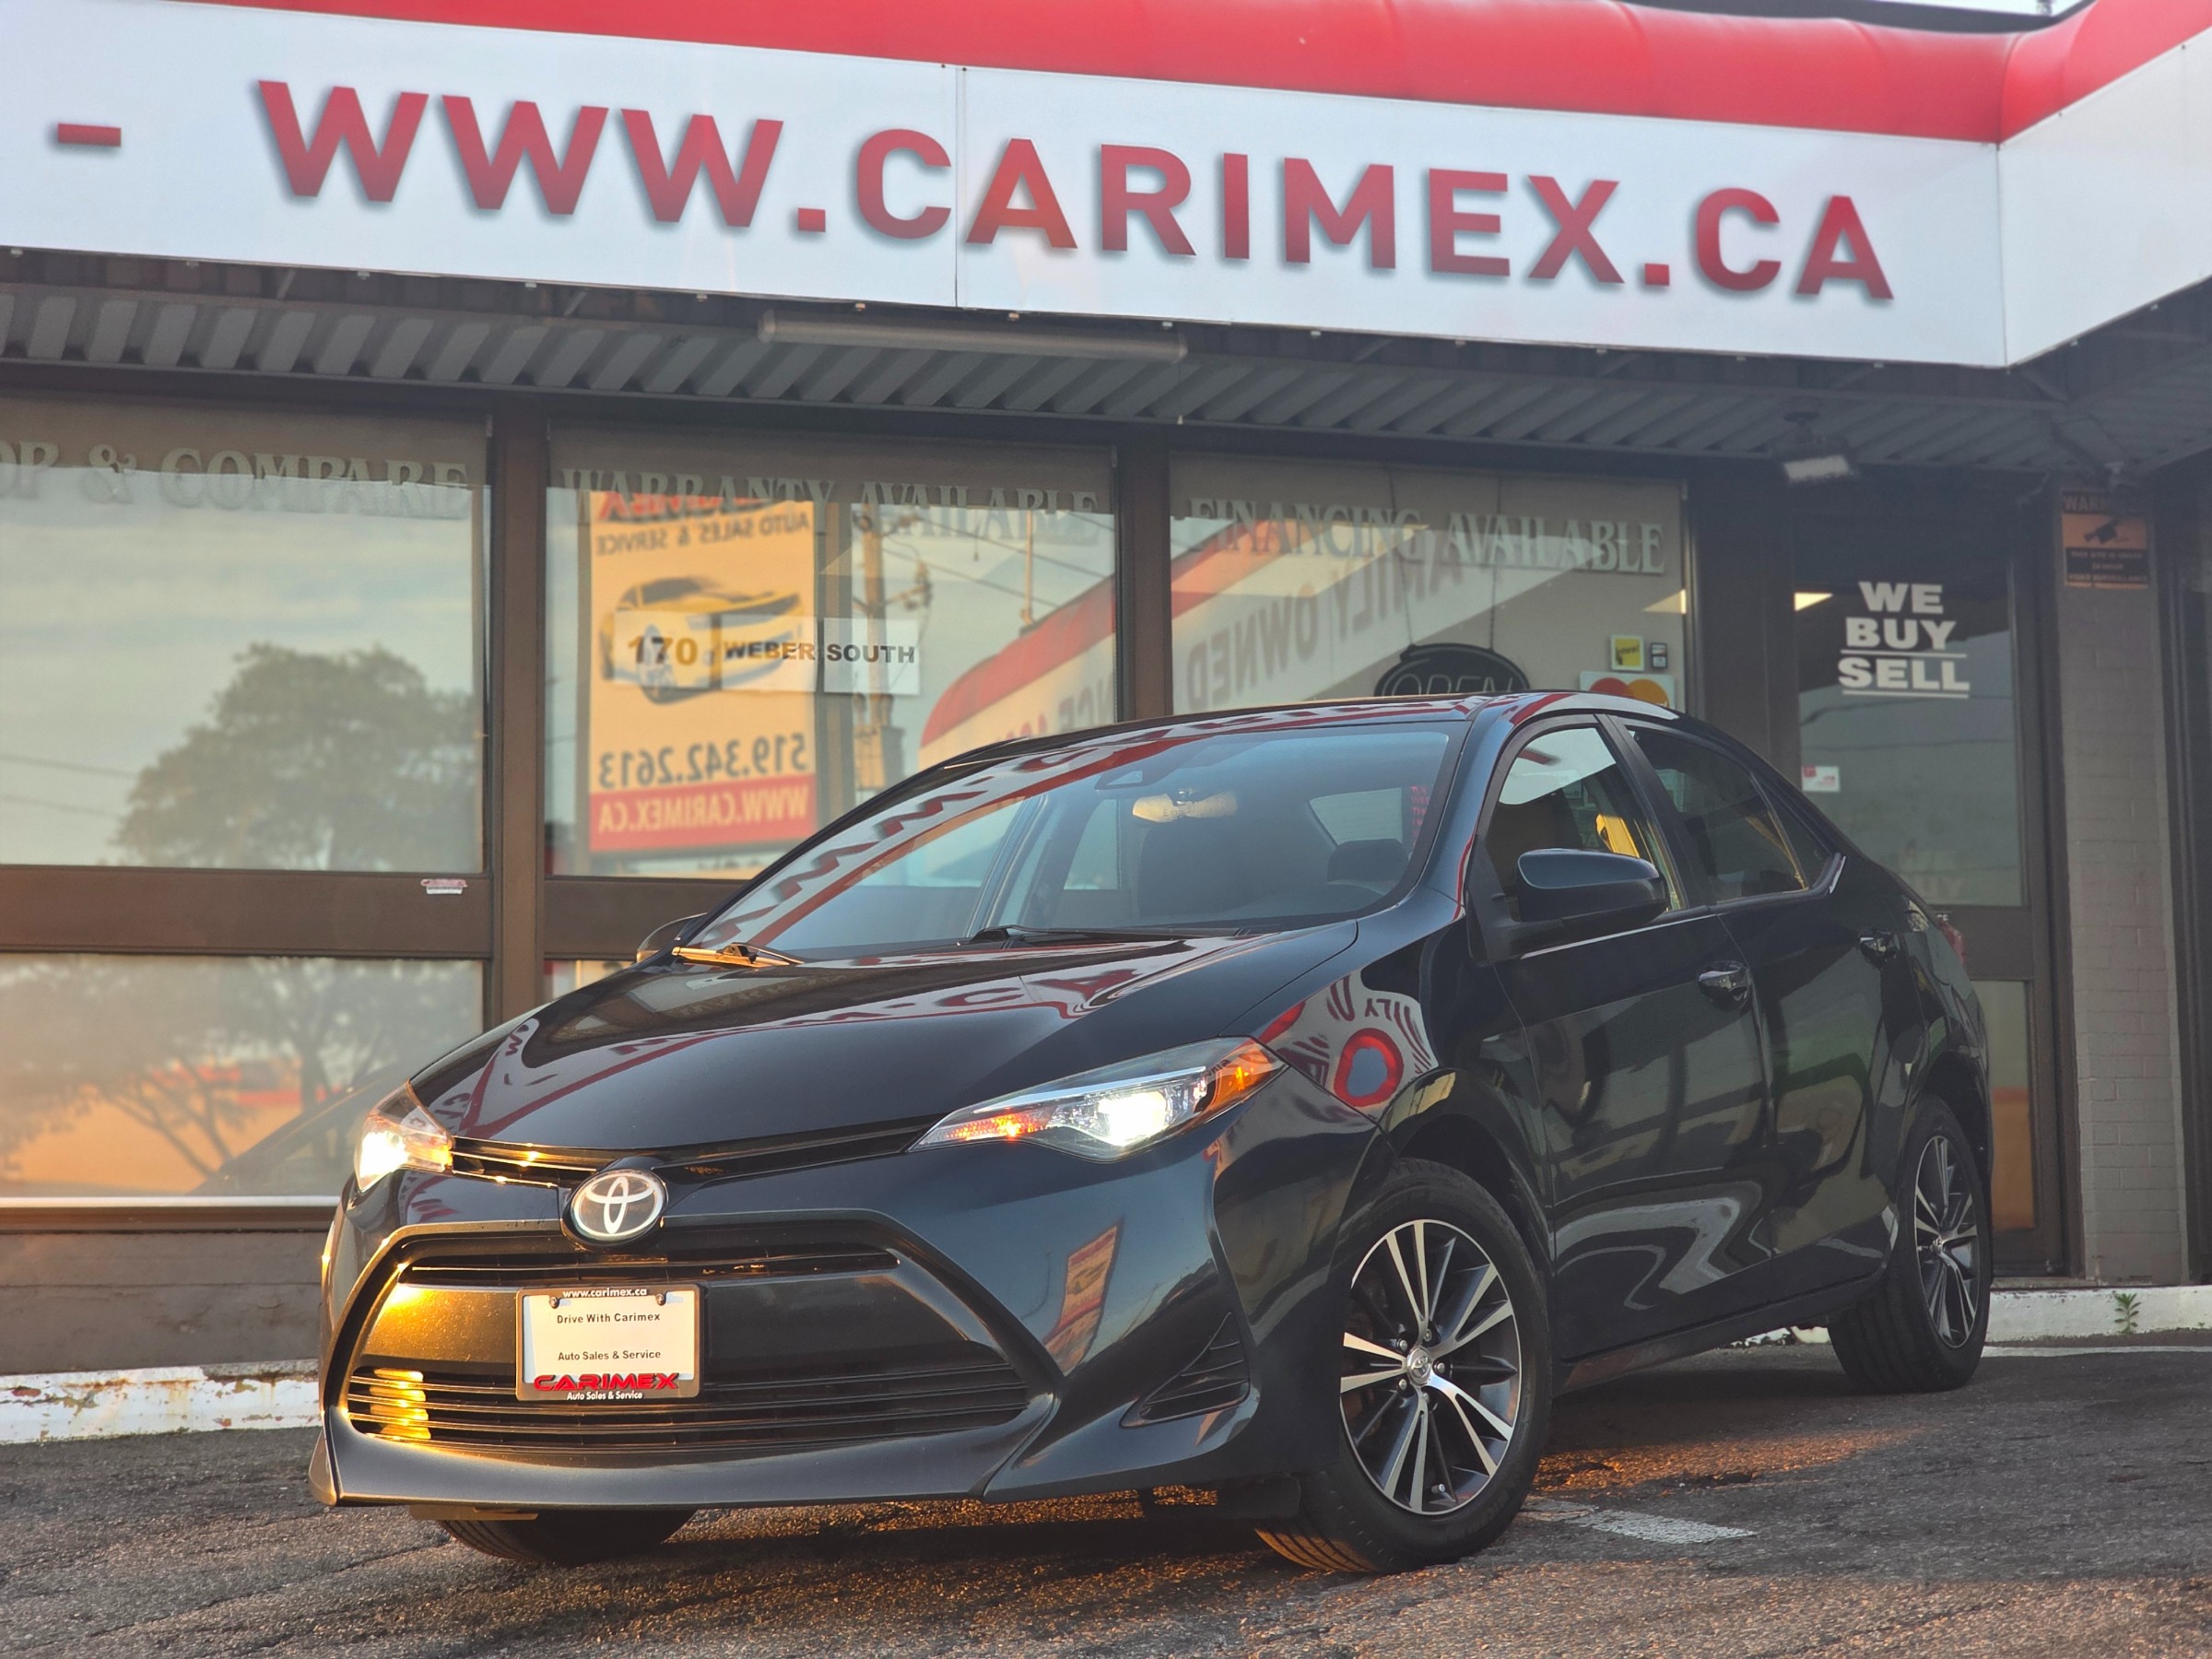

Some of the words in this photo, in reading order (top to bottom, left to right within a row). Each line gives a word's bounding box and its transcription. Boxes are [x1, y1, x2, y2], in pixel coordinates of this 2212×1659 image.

[257, 79, 1893, 300] WWW.CARIMEX.CA
[159, 447, 472, 520] COMPARE
[560, 468, 835, 534] WARRANTY
[861, 481, 1100, 545] AVAILABLE
[1189, 498, 1422, 564] FINANCING
[1442, 512, 1665, 575] AVAILABLE
[1858, 581, 1944, 615] WE
[628, 636, 699, 666] 170
[725, 641, 817, 663] WEBER
[826, 643, 915, 665] SOUTH
[1845, 617, 1957, 651] BUY
[1837, 656, 1971, 691] SELL
[562, 1287, 647, 1299] www.carimex.ca
[557, 1314, 583, 1324] Drive
[586, 1313, 611, 1323] With
[614, 1312, 661, 1322] Carimex
[558, 1351, 580, 1360] Auto
[582, 1350, 609, 1360] Sales
[612, 1350, 620, 1359] &
[622, 1349, 661, 1359] Service
[534, 1371, 680, 1392] CARIMEX
[566, 1391, 584, 1401] Auto
[586, 1391, 606, 1401] Sales
[607, 1392, 615, 1400] &
[616, 1390, 643, 1400] Service
